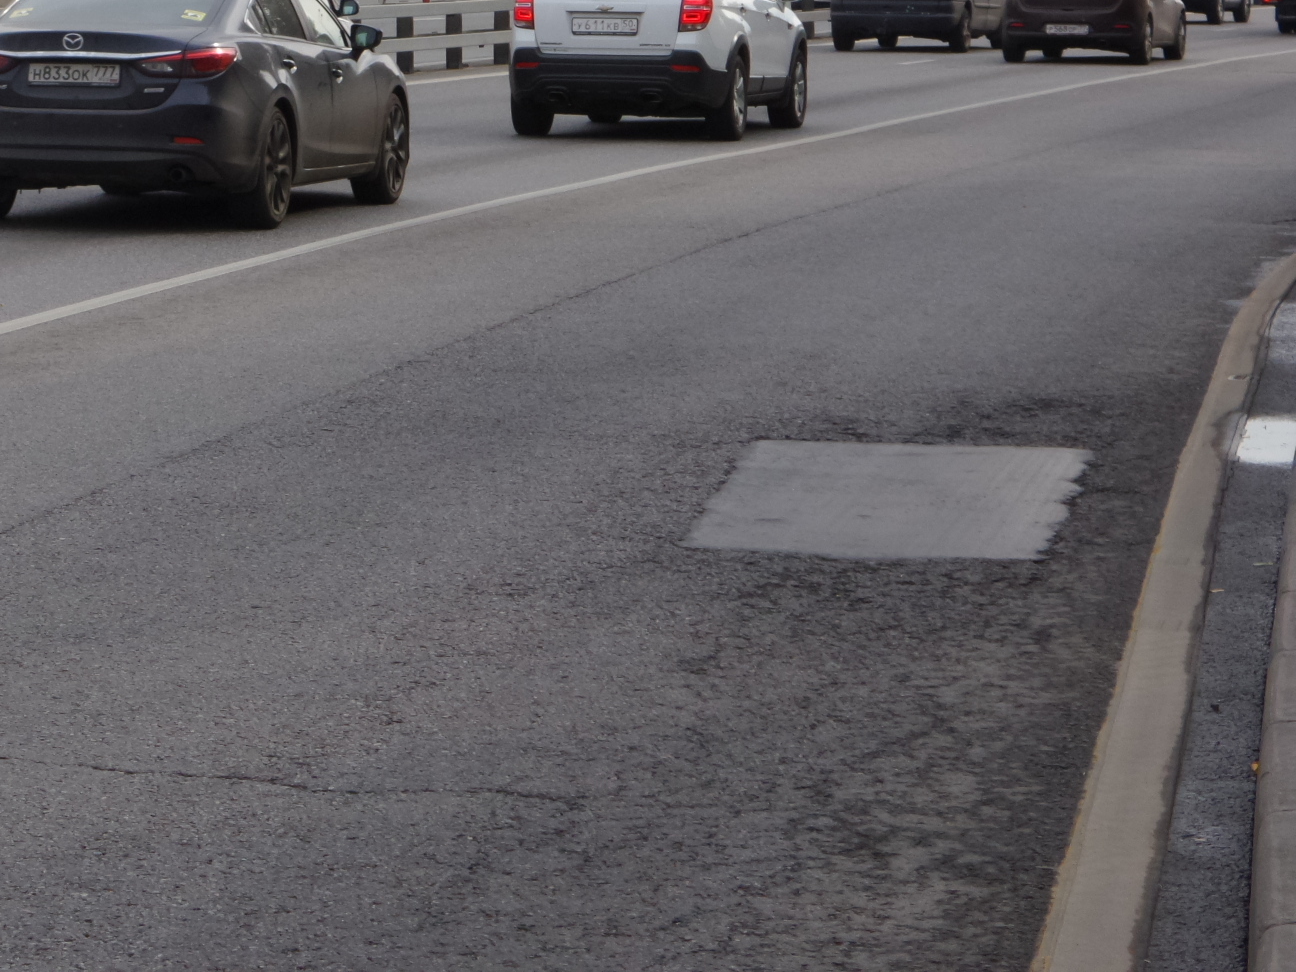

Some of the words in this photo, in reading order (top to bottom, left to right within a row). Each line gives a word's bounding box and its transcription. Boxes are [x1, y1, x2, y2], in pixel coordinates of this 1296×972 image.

[576, 19, 620, 31] У611КВ
[33, 65, 90, 82] Н833ОК
[94, 66, 117, 78] 777
